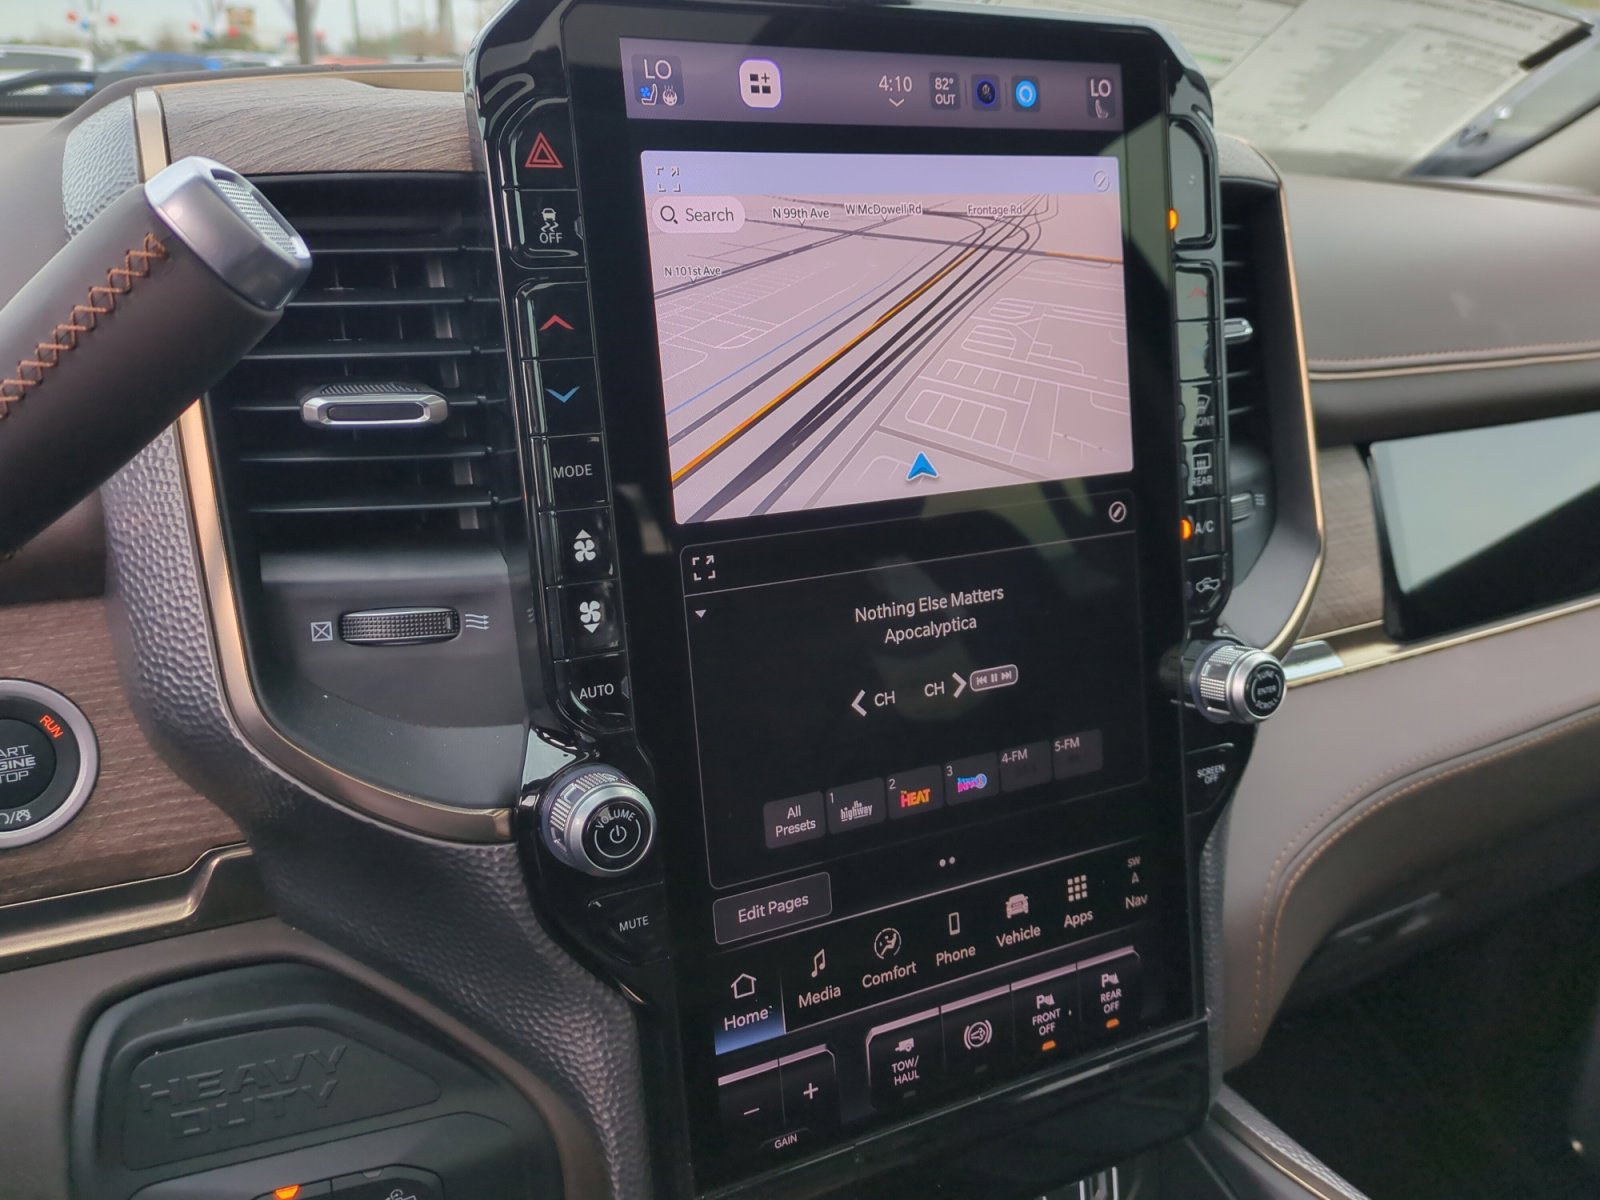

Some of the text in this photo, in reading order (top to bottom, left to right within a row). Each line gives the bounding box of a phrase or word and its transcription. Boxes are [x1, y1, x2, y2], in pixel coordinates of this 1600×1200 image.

[643, 58, 672, 80] LO
[878, 74, 913, 93] 4:10
[934, 77, 954, 91] 82°
[1090, 79, 1112, 98] LO
[935, 94, 955, 105] OUT
[685, 207, 735, 222] Search
[772, 207, 830, 219] N 99th Ave
[845, 203, 922, 215] W McDowell Rd
[968, 204, 1023, 217] Frontage Rd
[539, 232, 563, 244] OFF
[664, 265, 721, 277] N 101st Ave
[552, 463, 593, 479] MODE
[1194, 520, 1215, 533] A/C
[855, 588, 1004, 623] Nothing Else Matters
[885, 617, 977, 644] Apocalyptica
[579, 683, 615, 700] AUTO
[924, 681, 945, 697] CH
[874, 691, 896, 707] CH
[40, 715, 63, 738] RUN
[0, 744, 29, 757] ART
[1054, 736, 1081, 752] 5-FM
[0, 756, 36, 771] GINE
[1001, 748, 1029, 764] 4-FM
[0, 770, 29, 785] TOP
[946, 765, 954, 776] 3
[1197, 764, 1225, 778] SCREEN
[888, 778, 897, 790] 2
[1204, 774, 1219, 785] OFF
[830, 792, 834, 804] 1
[900, 788, 931, 808] HEAT
[595, 808, 637, 830] VOLUME
[786, 804, 802, 820] All
[840, 804, 873, 822] highway
[775, 819, 817, 838] Presets
[737, 894, 809, 924] Edit Pages
[1125, 893, 1148, 910] Nav
[618, 915, 649, 933] MUTE
[1063, 909, 1094, 929] Apps
[996, 924, 1041, 948] Vehicle
[935, 945, 976, 967] Phone
[862, 961, 917, 987] Comfort
[798, 984, 841, 1009] Media
[1100, 988, 1122, 1004] REAR
[1103, 1000, 1120, 1014] OFF
[723, 1007, 769, 1032] Home
[1032, 1008, 1061, 1026] FRONT
[1038, 1022, 1056, 1036] OFF
[891, 1055, 919, 1075] TOW/
[139, 1045, 347, 1112] HEAVY
[894, 1070, 920, 1087] HAUL
[170, 1079, 338, 1140] DUTY
[774, 1133, 798, 1150] GAIN
